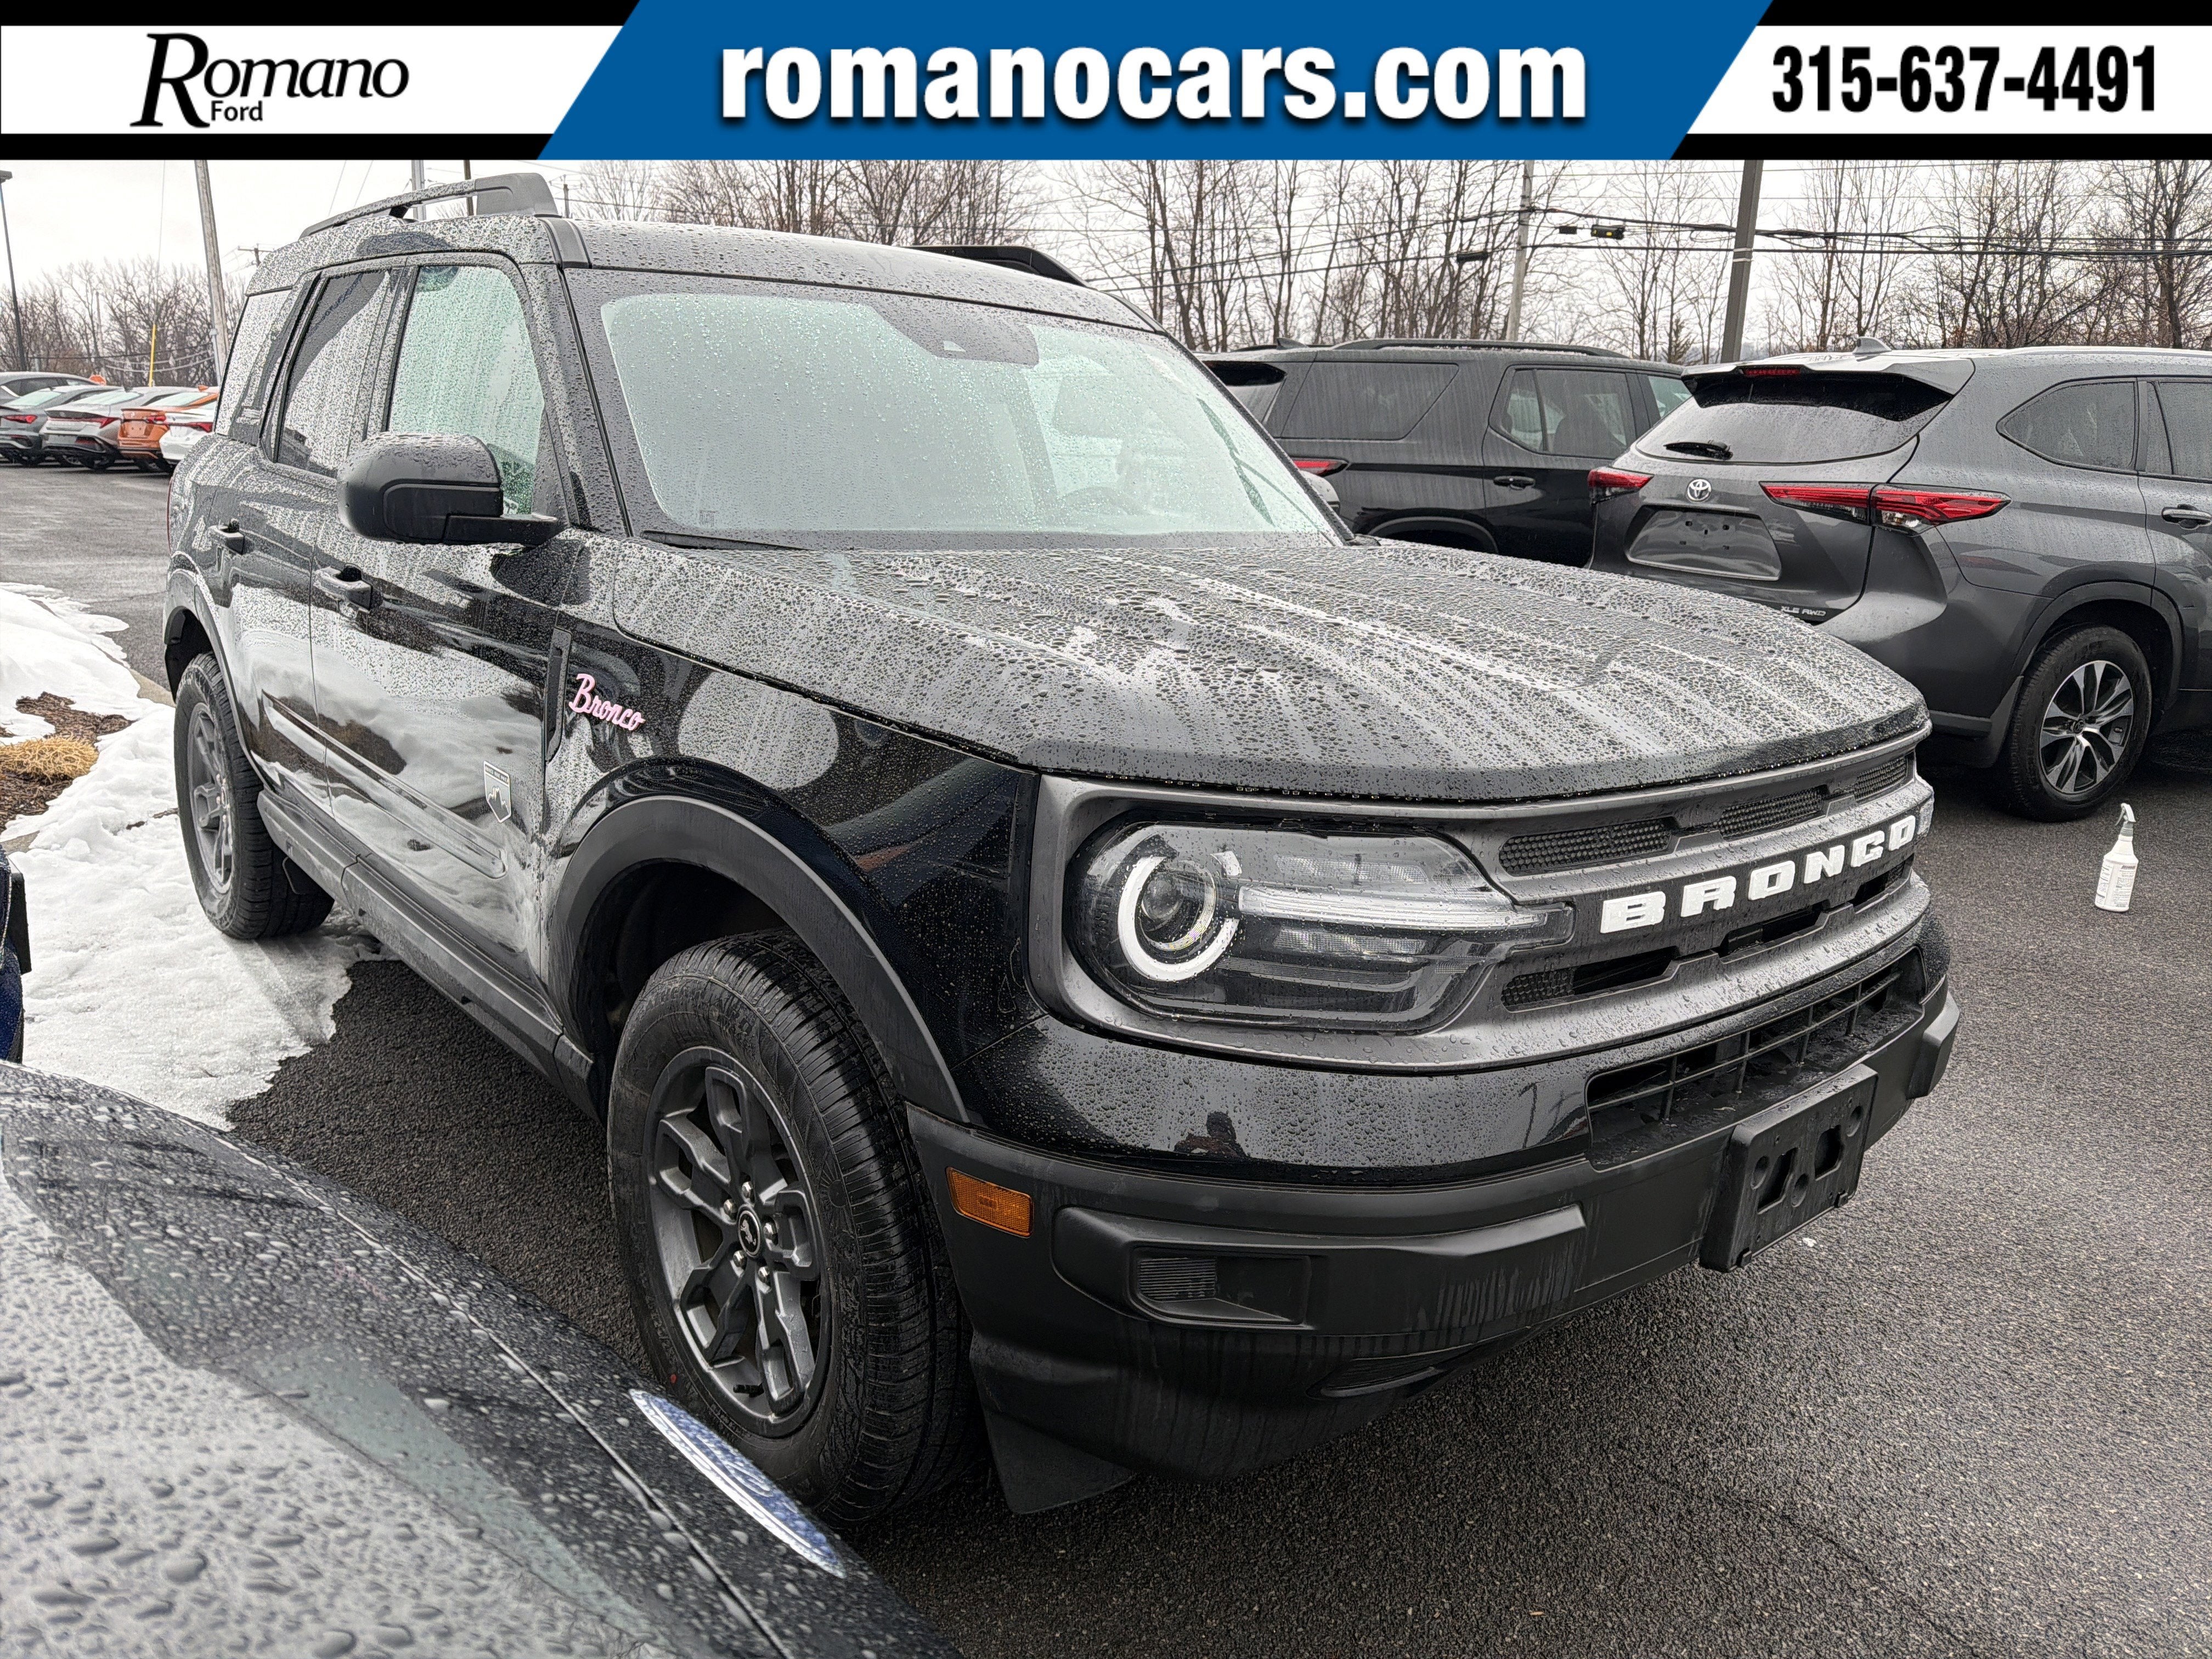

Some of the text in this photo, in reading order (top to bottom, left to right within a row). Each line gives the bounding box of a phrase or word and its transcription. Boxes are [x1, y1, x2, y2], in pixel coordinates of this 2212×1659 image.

[1781, 606, 1826, 617] XLE AWD
[568, 673, 646, 731] Bronco
[1600, 815, 1916, 934] BRONCO
